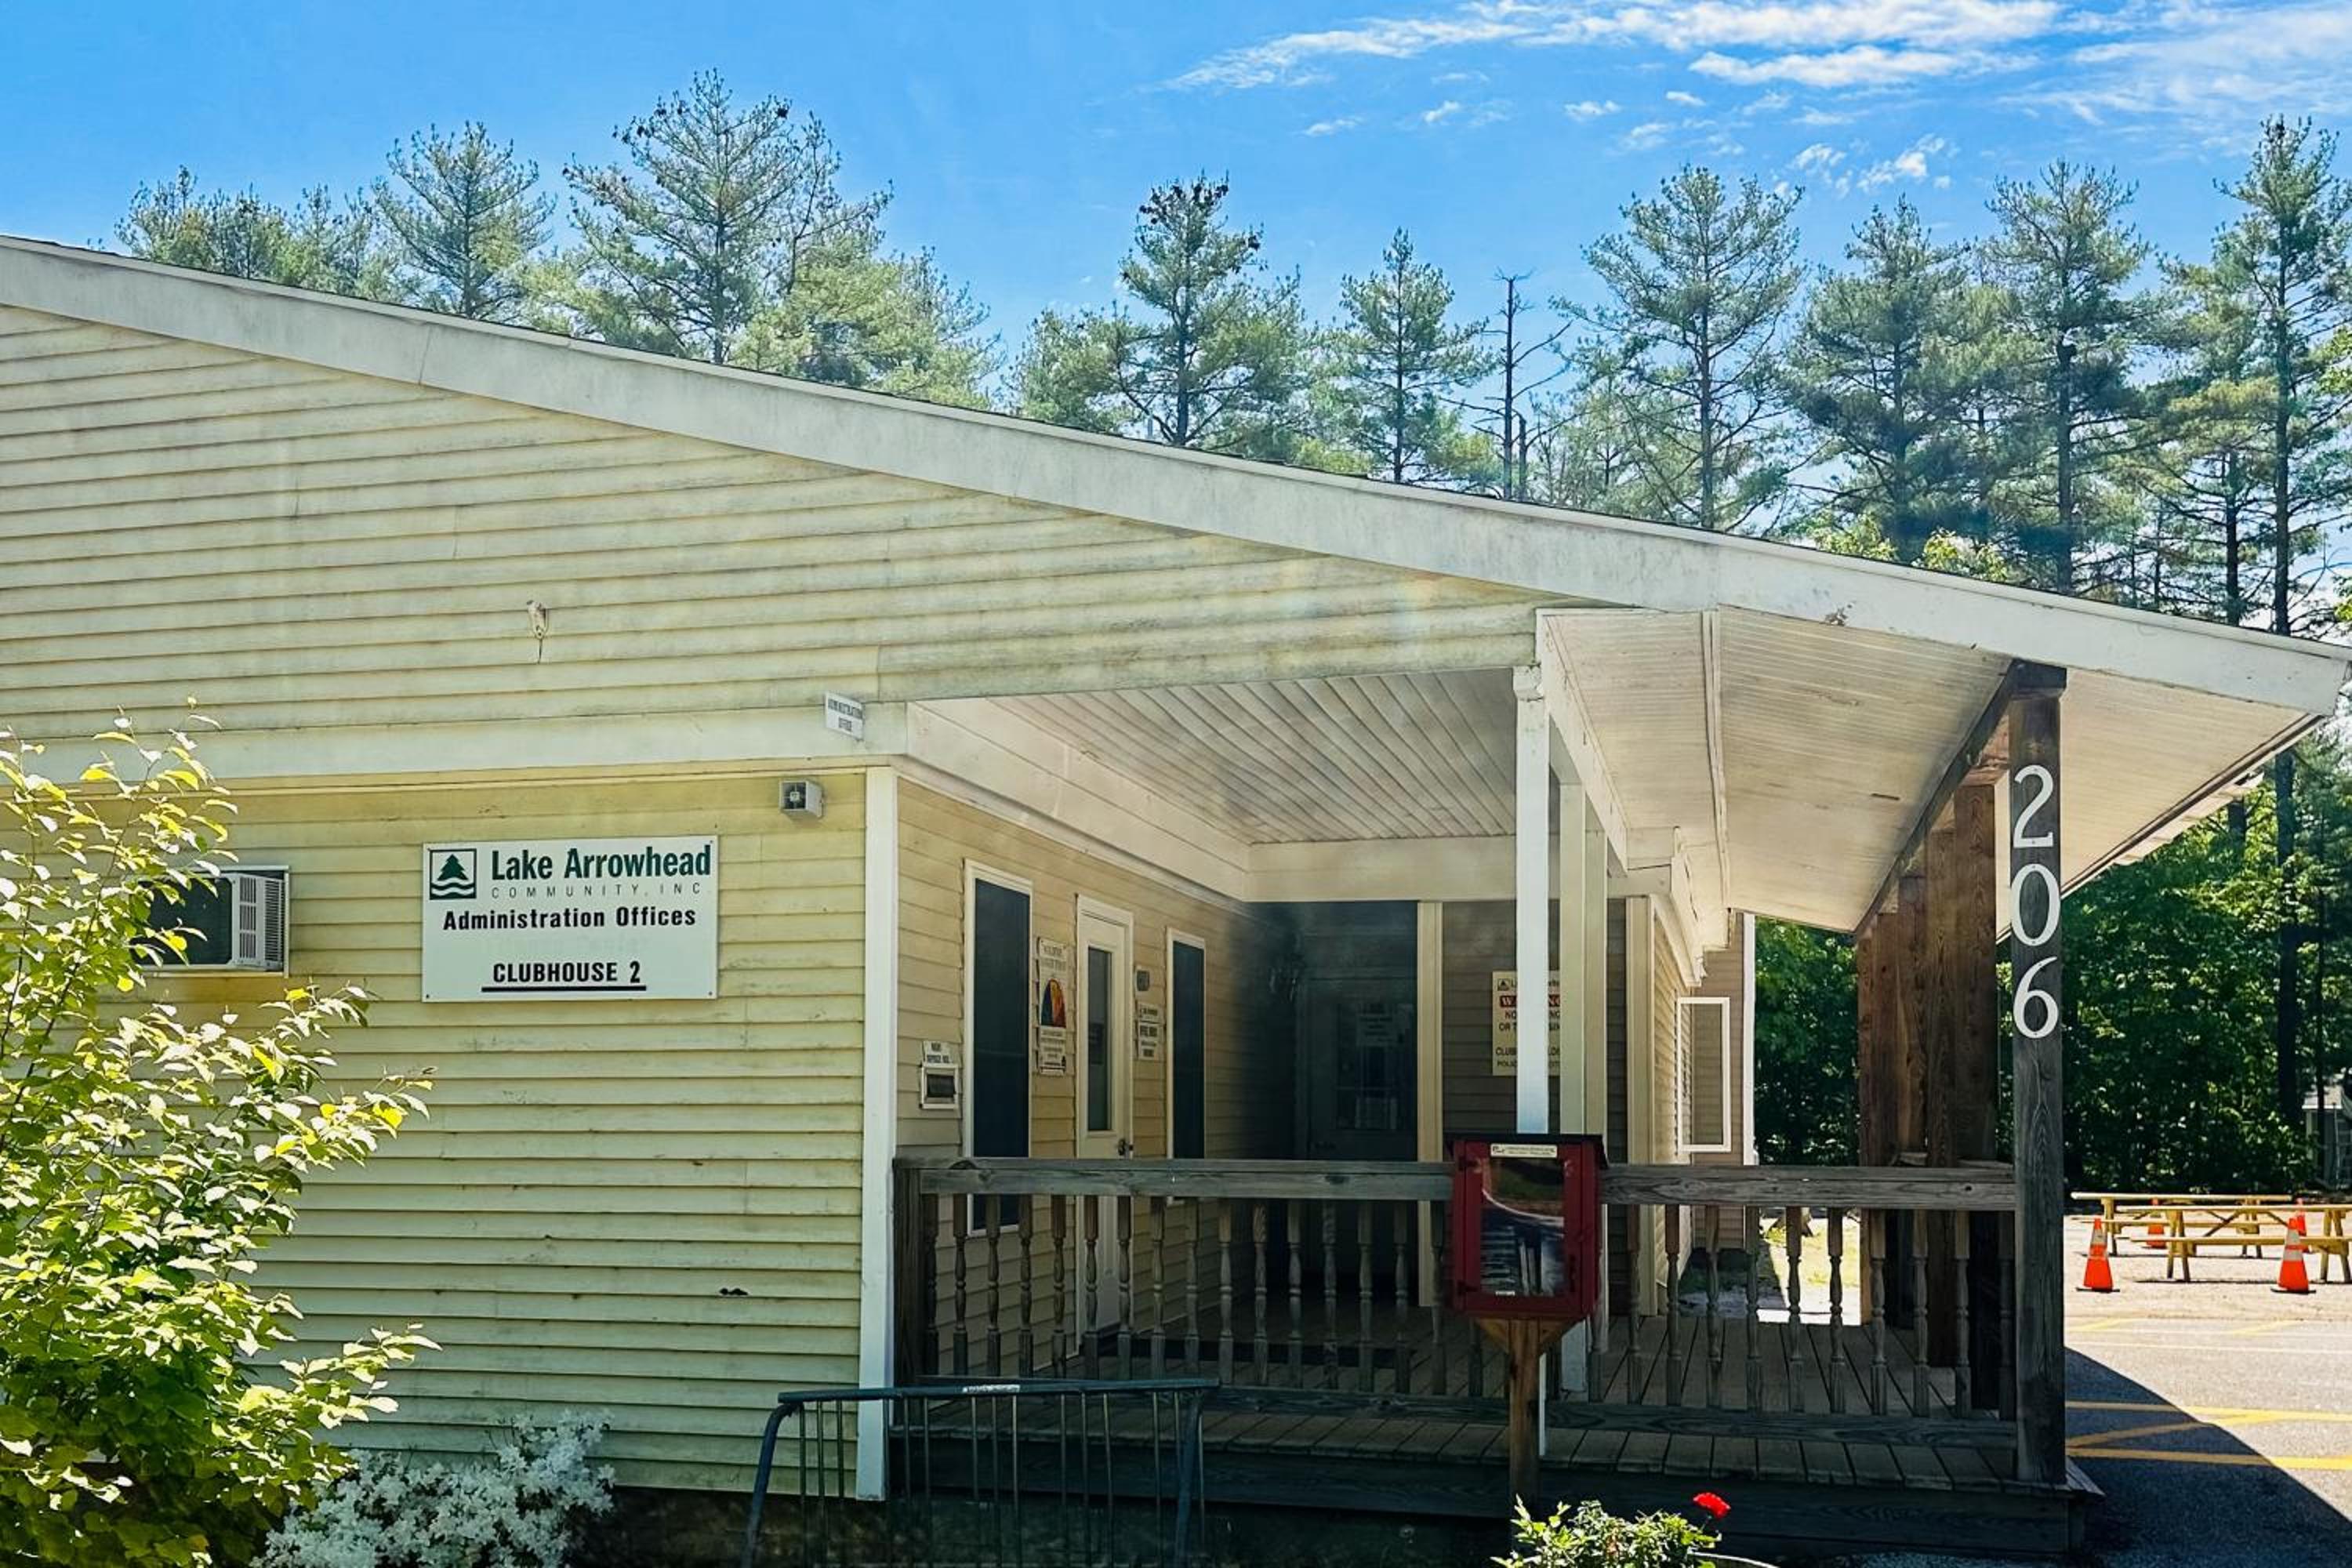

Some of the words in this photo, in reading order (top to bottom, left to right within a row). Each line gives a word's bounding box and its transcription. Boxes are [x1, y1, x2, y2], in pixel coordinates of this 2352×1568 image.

[492, 849, 553, 880] Lake
[564, 844, 712, 879] Arrowhead
[2011, 764, 2061, 1040] 206
[443, 907, 604, 931] Administration
[615, 906, 696, 927] Offices
[493, 962, 618, 983] CLUBHOUSE
[630, 960, 641, 984] 2
